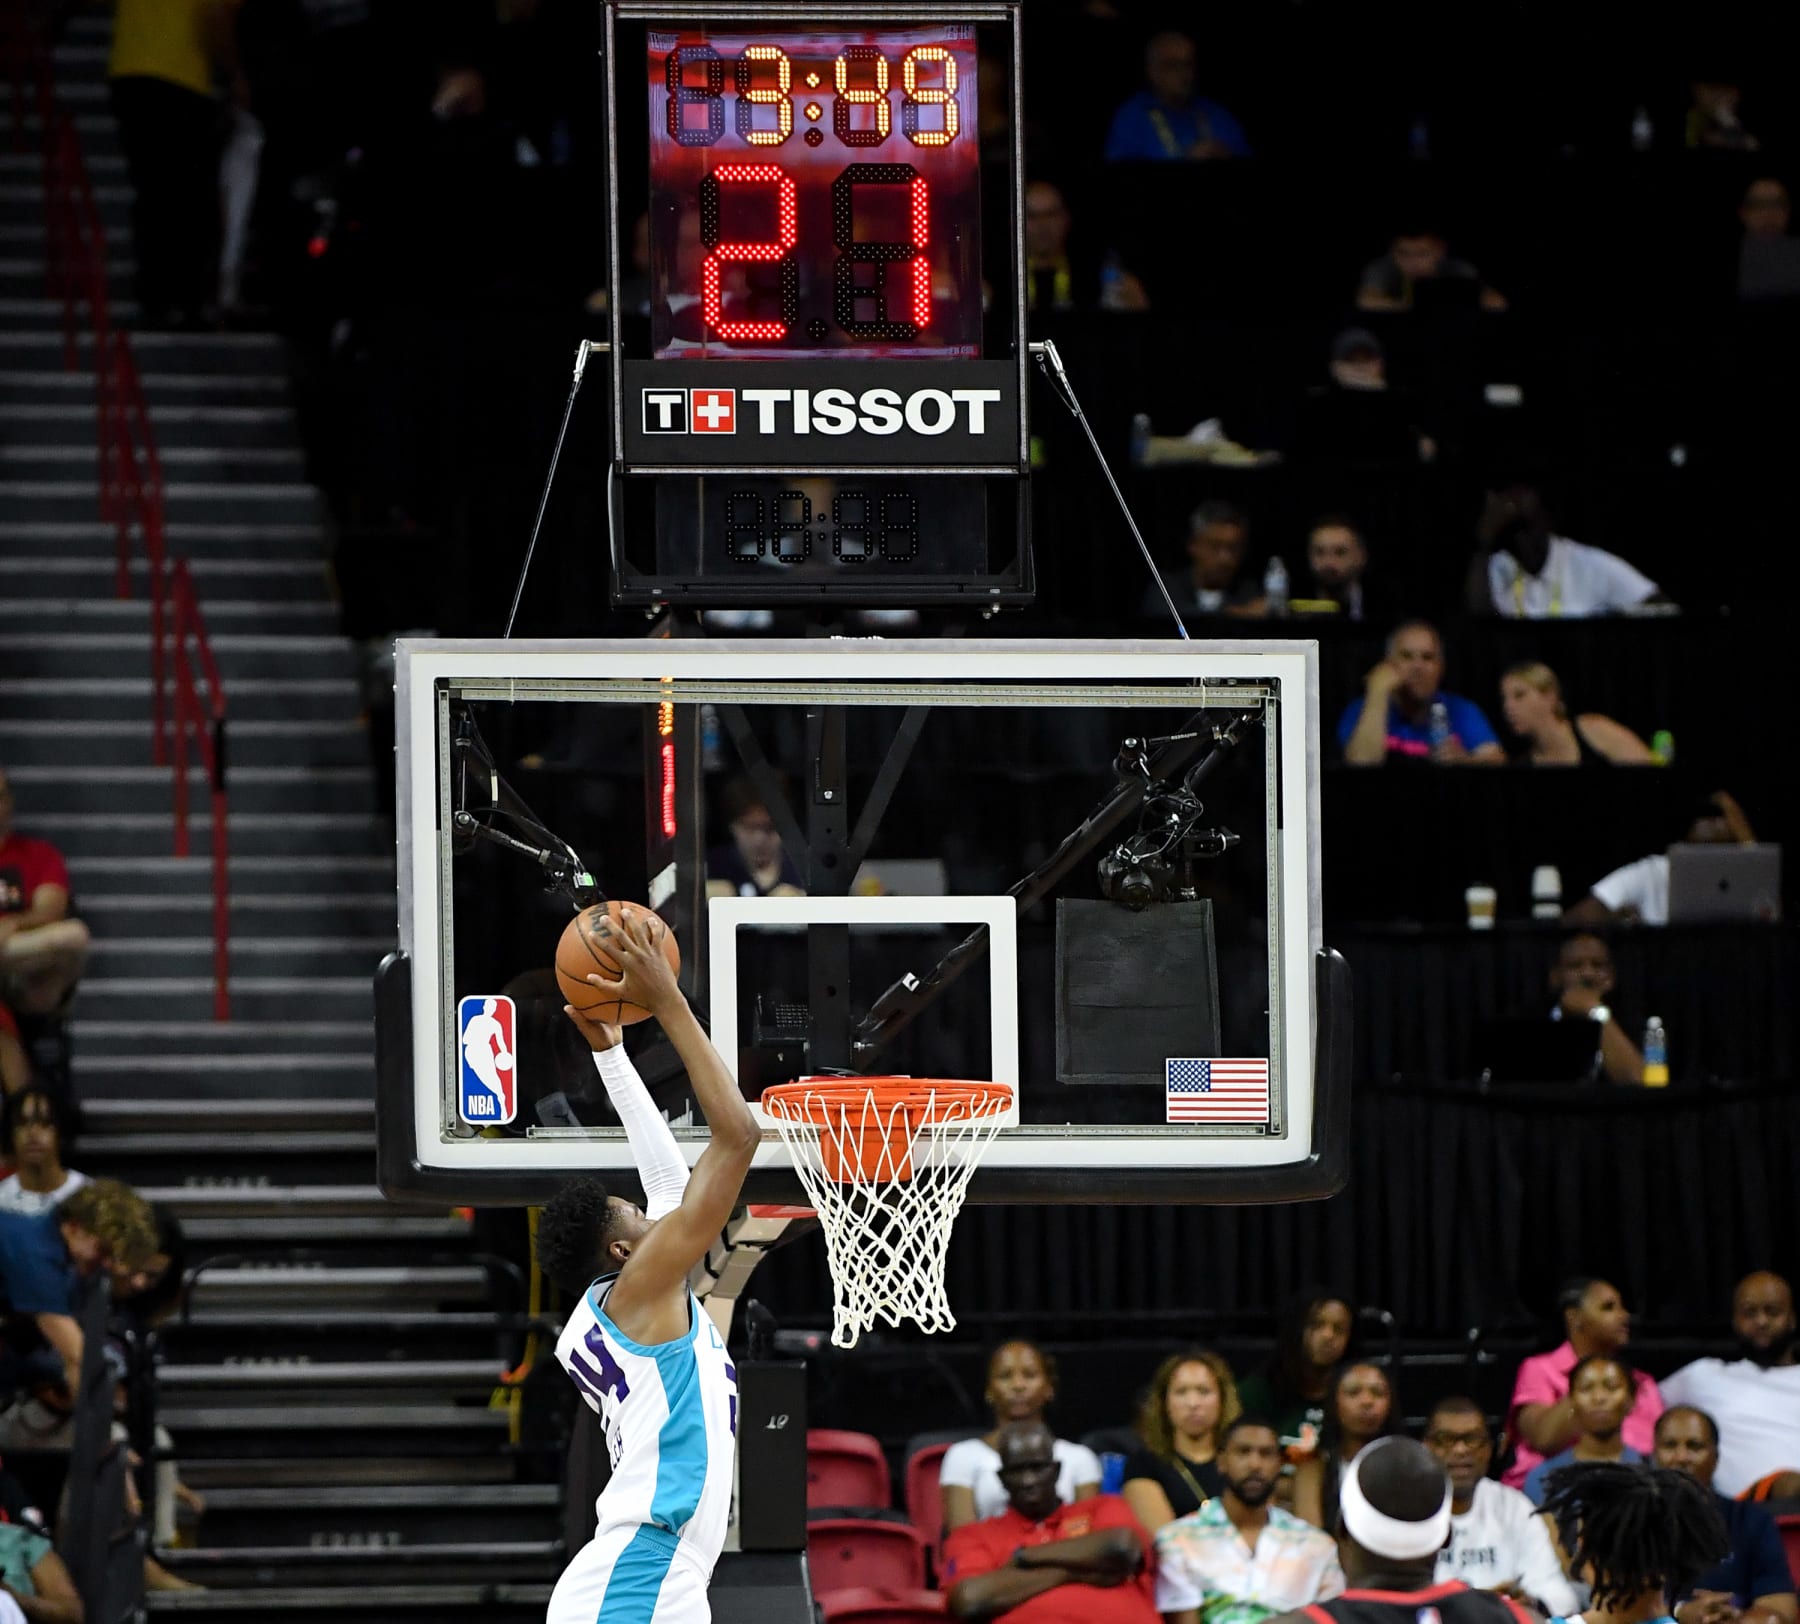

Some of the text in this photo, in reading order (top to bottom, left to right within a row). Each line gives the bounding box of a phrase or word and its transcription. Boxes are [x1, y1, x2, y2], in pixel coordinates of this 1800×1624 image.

[744, 46, 958, 146] 3:49
[703, 164, 930, 340] 21
[742, 388, 1001, 435] TISSOT
[468, 1094, 496, 1116] NBA
